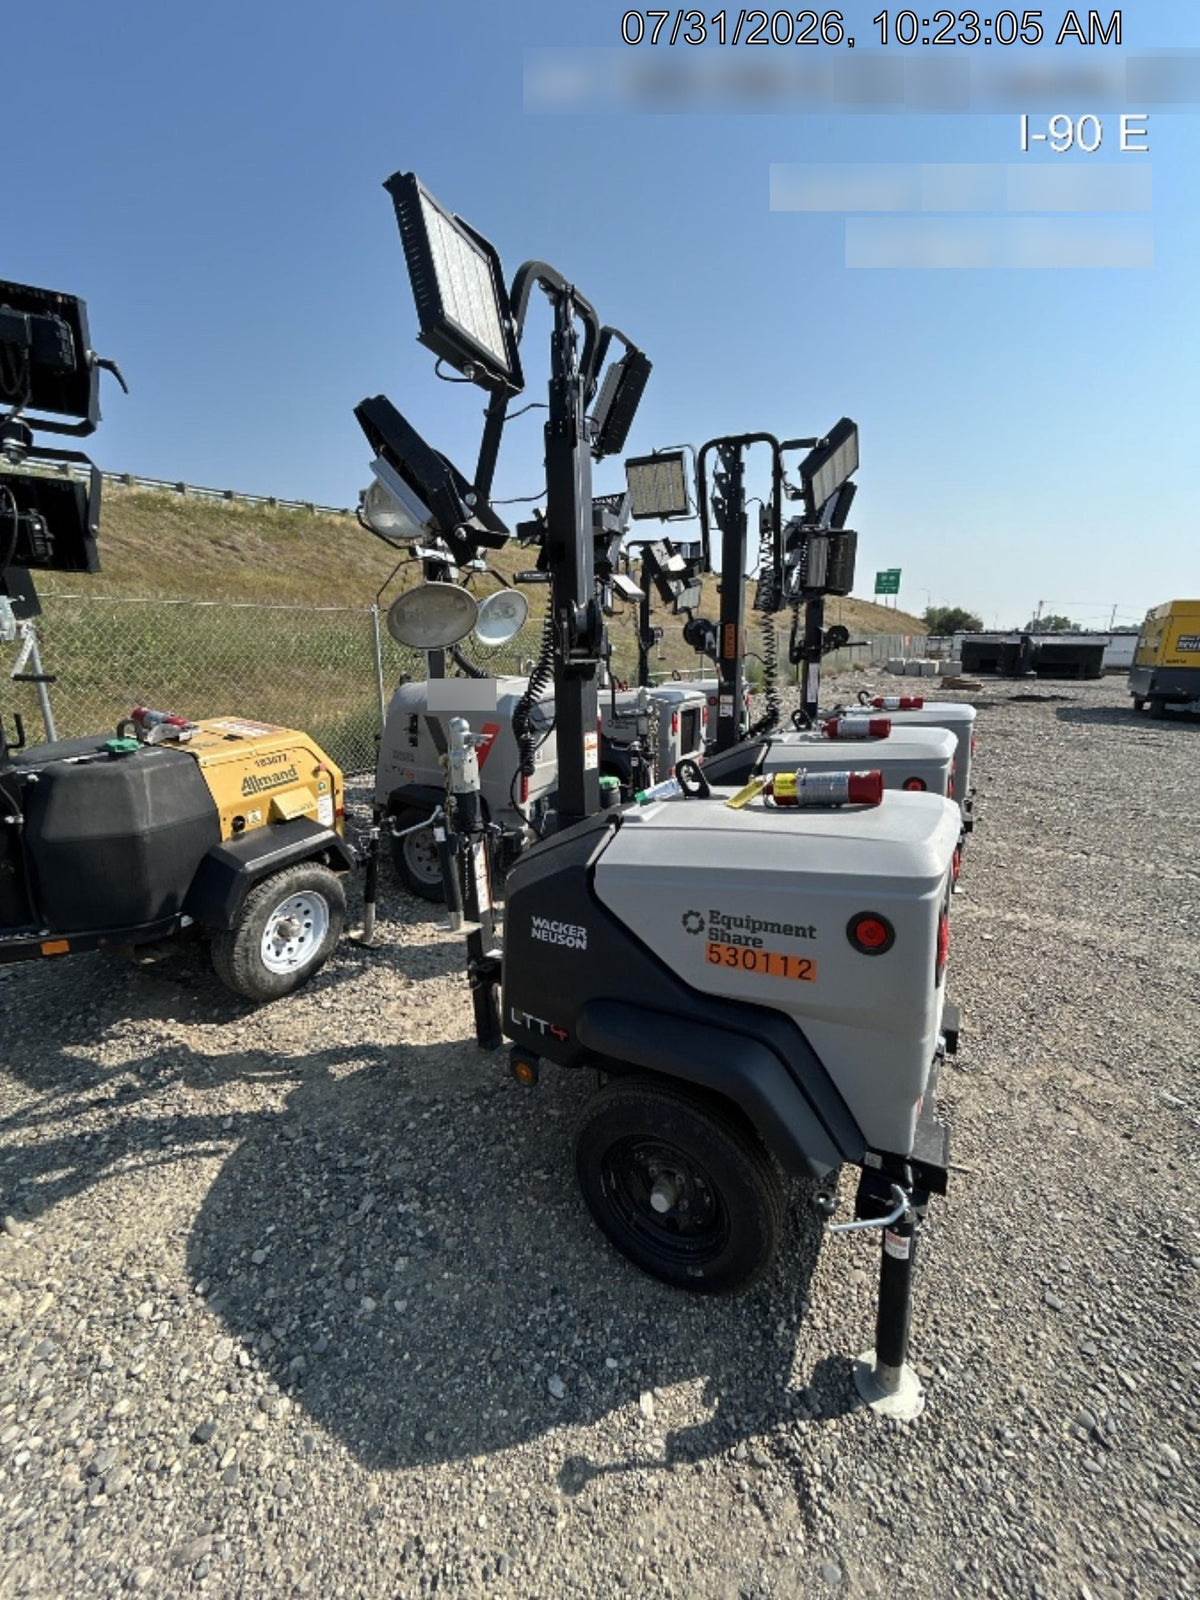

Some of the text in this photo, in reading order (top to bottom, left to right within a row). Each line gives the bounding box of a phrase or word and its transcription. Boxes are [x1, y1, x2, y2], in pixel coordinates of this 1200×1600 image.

[241, 764, 298, 793] Allmand
[531, 915, 587, 940] WACKER
[708, 909, 817, 940] Equipment
[708, 927, 764, 948] Share
[531, 927, 587, 950] NEUSON
[708, 943, 813, 981] 530112
